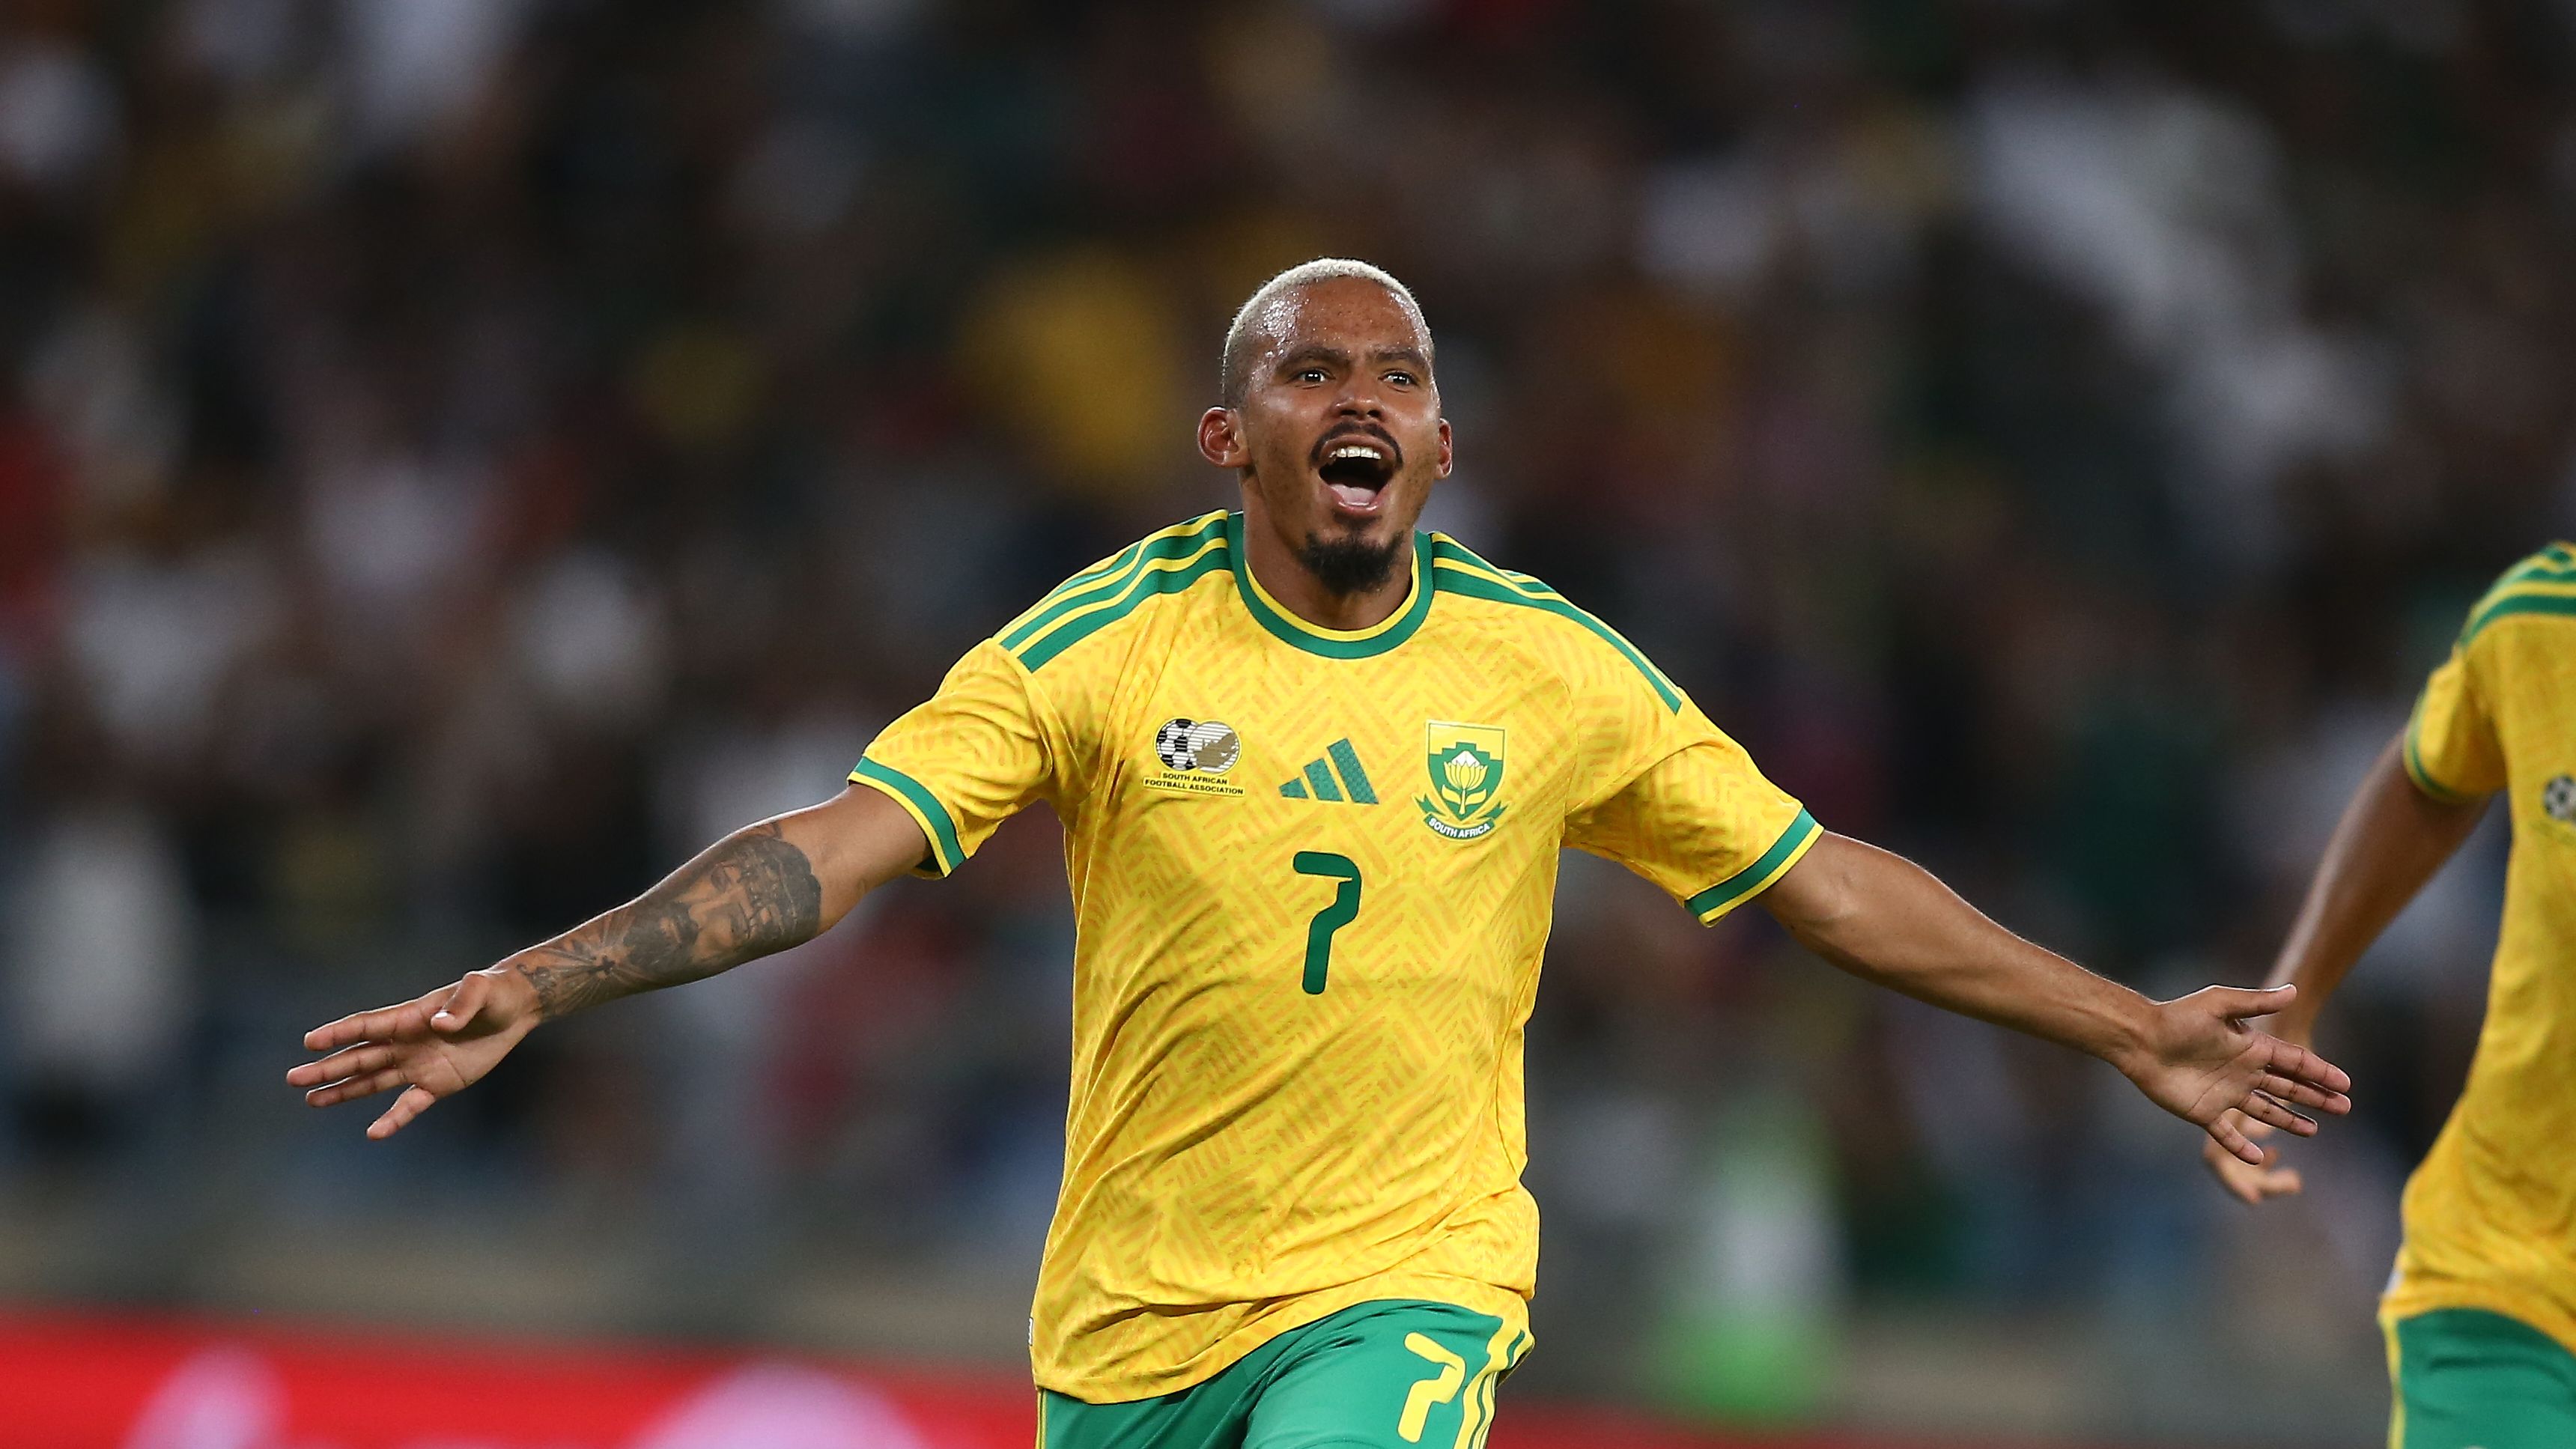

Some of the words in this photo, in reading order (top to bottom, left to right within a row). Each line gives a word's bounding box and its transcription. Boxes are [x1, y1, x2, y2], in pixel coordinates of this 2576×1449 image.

[1145, 779, 1187, 789] FOOTBALL
[1189, 784, 1244, 795] ASSOCIATION
[1162, 772, 1190, 781] SOUTH
[1192, 776, 1227, 785] AFRICAN
[1428, 818, 1457, 837] SOUTH
[1457, 823, 1490, 838] AFRICA
[1293, 851, 1362, 995] 7
[1397, 1331, 1466, 1443] 7
